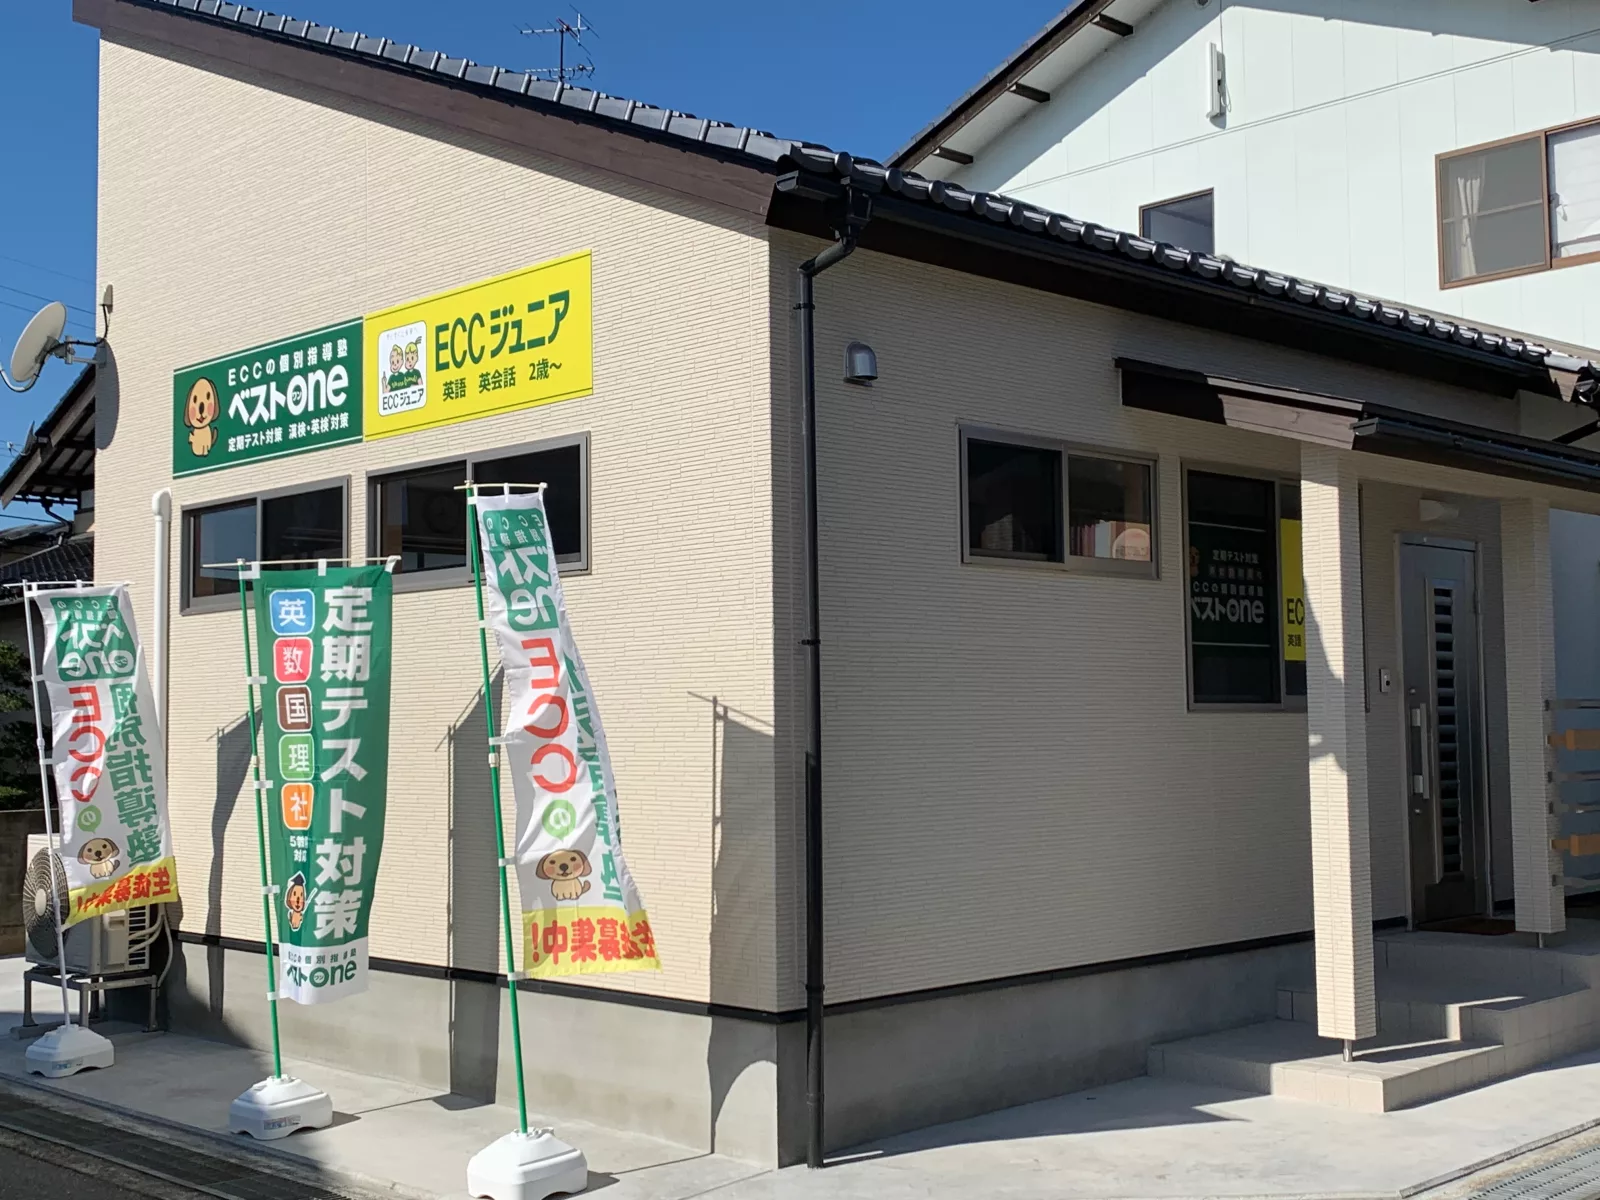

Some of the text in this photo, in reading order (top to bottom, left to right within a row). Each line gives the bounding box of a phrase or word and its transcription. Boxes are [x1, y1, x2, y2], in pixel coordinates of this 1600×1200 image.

[228, 338, 348, 386] ECCの個別指導塾
[435, 289, 571, 372] ECCジュニア
[443, 376, 467, 402] 英語
[478, 365, 517, 394] 英会話
[228, 426, 283, 452] 定期テスト対策
[278, 599, 310, 821] 英 数 国 理 社
[313, 586, 374, 939] 定期テスト対策
